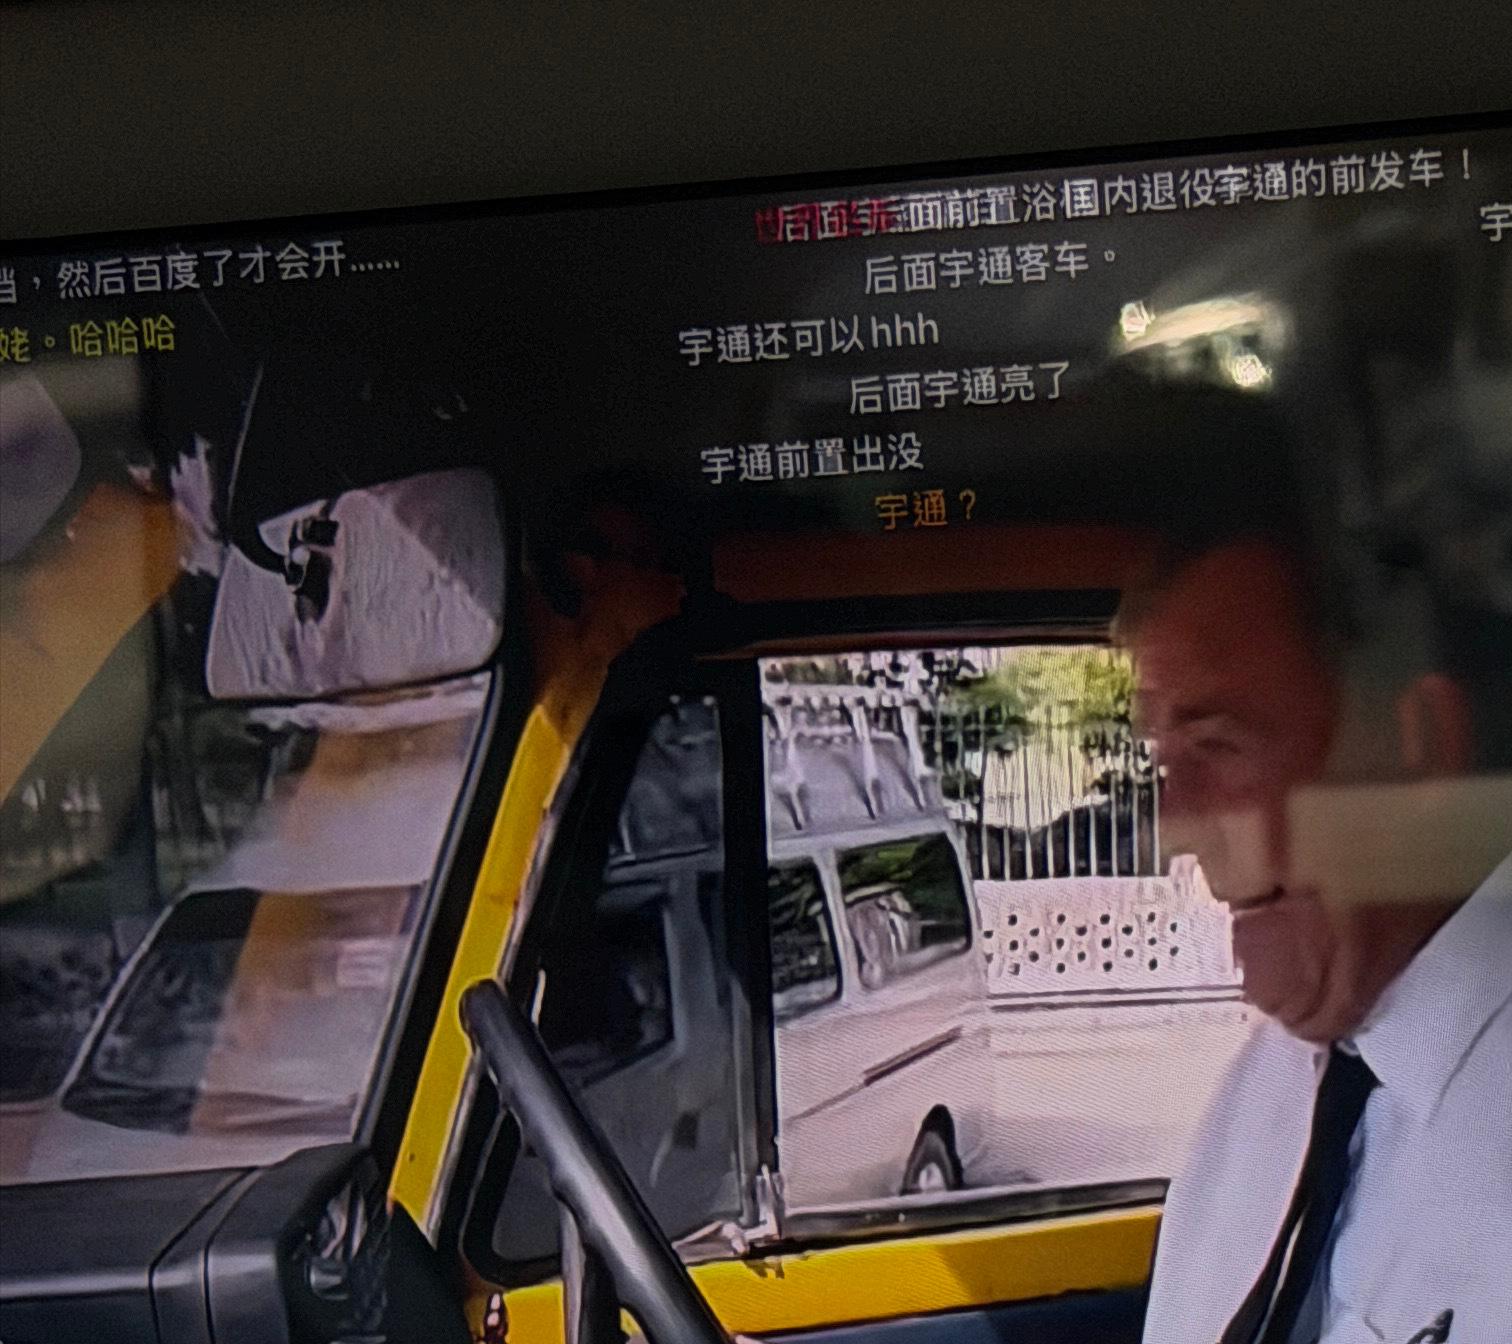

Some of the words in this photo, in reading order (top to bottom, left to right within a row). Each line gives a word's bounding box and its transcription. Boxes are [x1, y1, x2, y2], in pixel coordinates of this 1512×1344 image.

[849, 360, 1071, 416] 后面宇通亮了
[700, 432, 925, 485] 宇通前置出没
